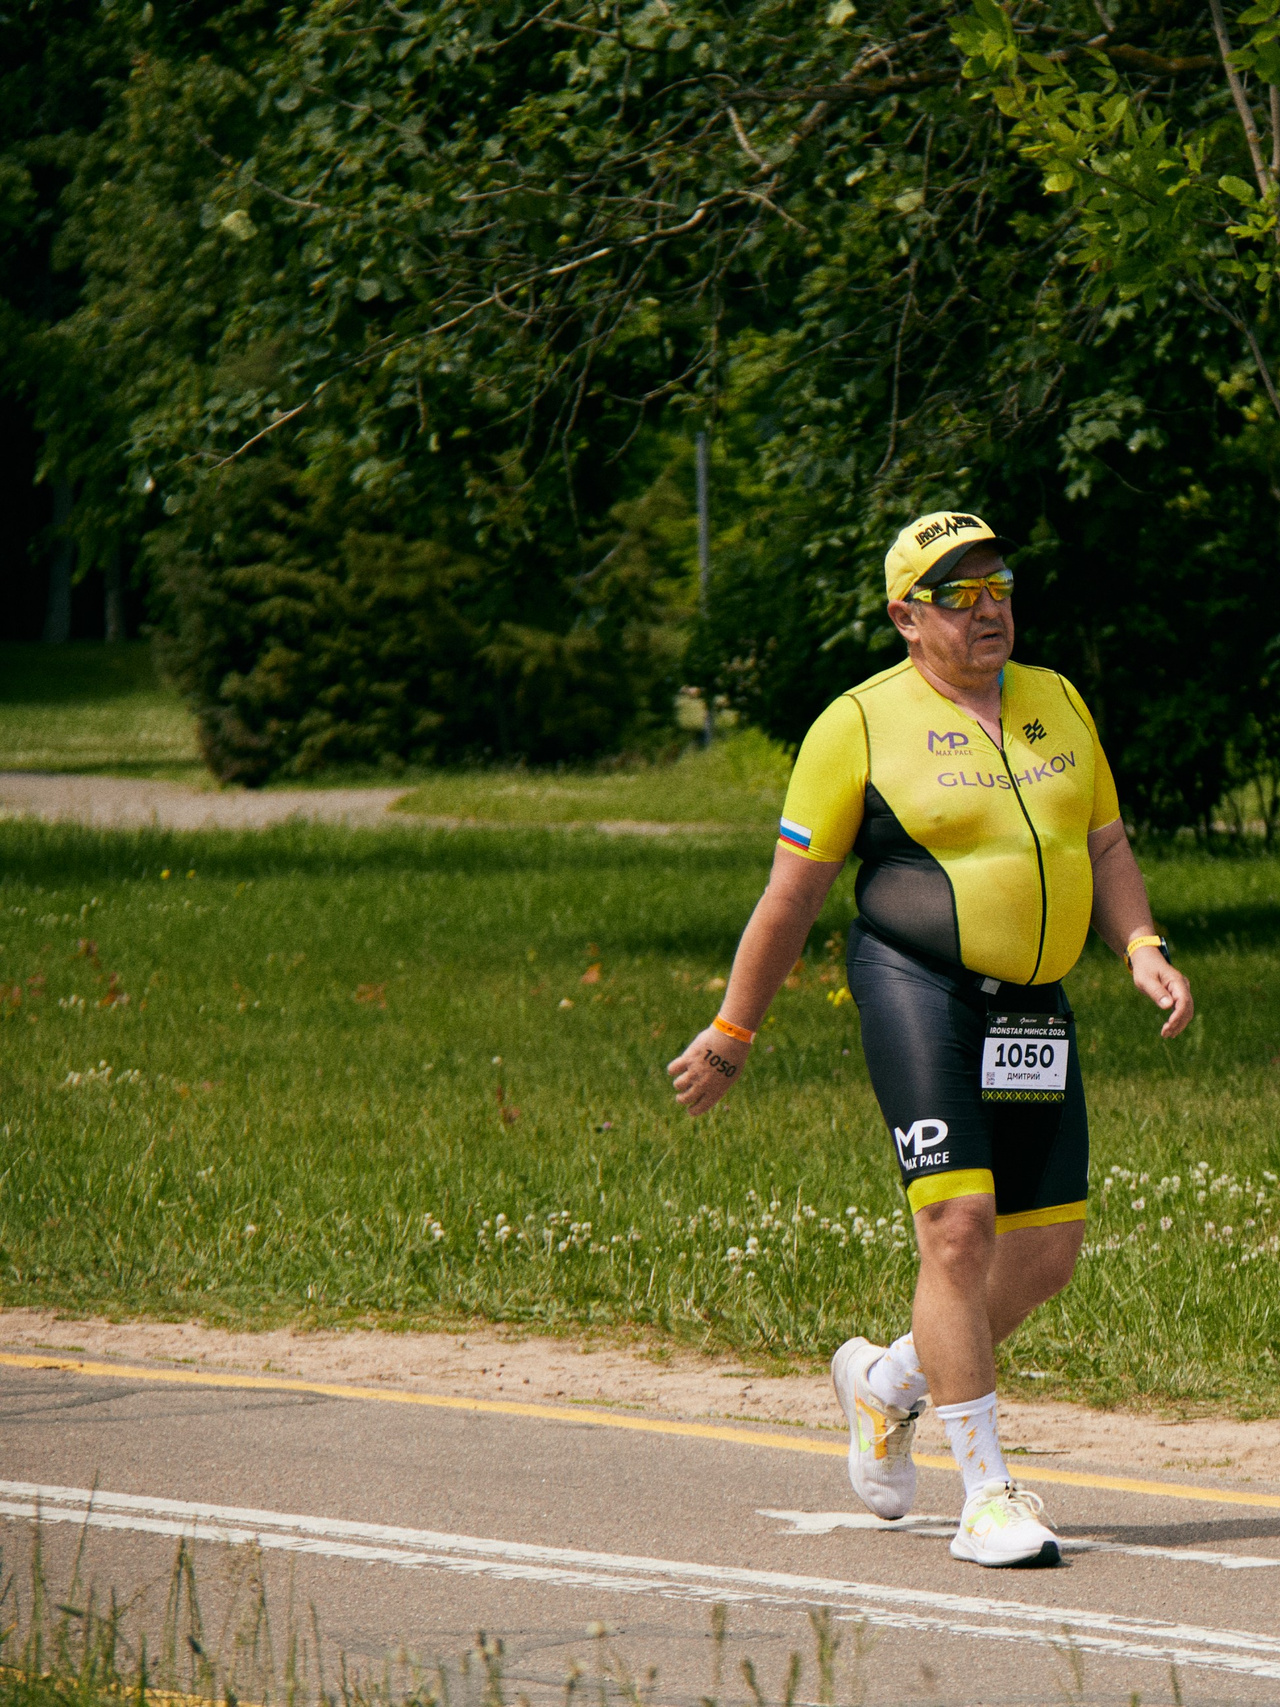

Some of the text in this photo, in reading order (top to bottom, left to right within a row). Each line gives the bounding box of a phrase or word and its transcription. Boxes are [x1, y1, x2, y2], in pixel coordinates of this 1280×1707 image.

[915, 522, 944, 546] IRON
[927, 730, 969, 753] MP
[937, 751, 1076, 790] GLUSHKOV
[989, 1026, 1023, 1035] IRONSTAR
[704, 1049, 737, 1078] 1050
[995, 1043, 1055, 1068] 1050
[1007, 1072, 1041, 1081] ДМИТРИЙ
[894, 1118, 949, 1168] MP
[920, 1151, 950, 1167] PACE
